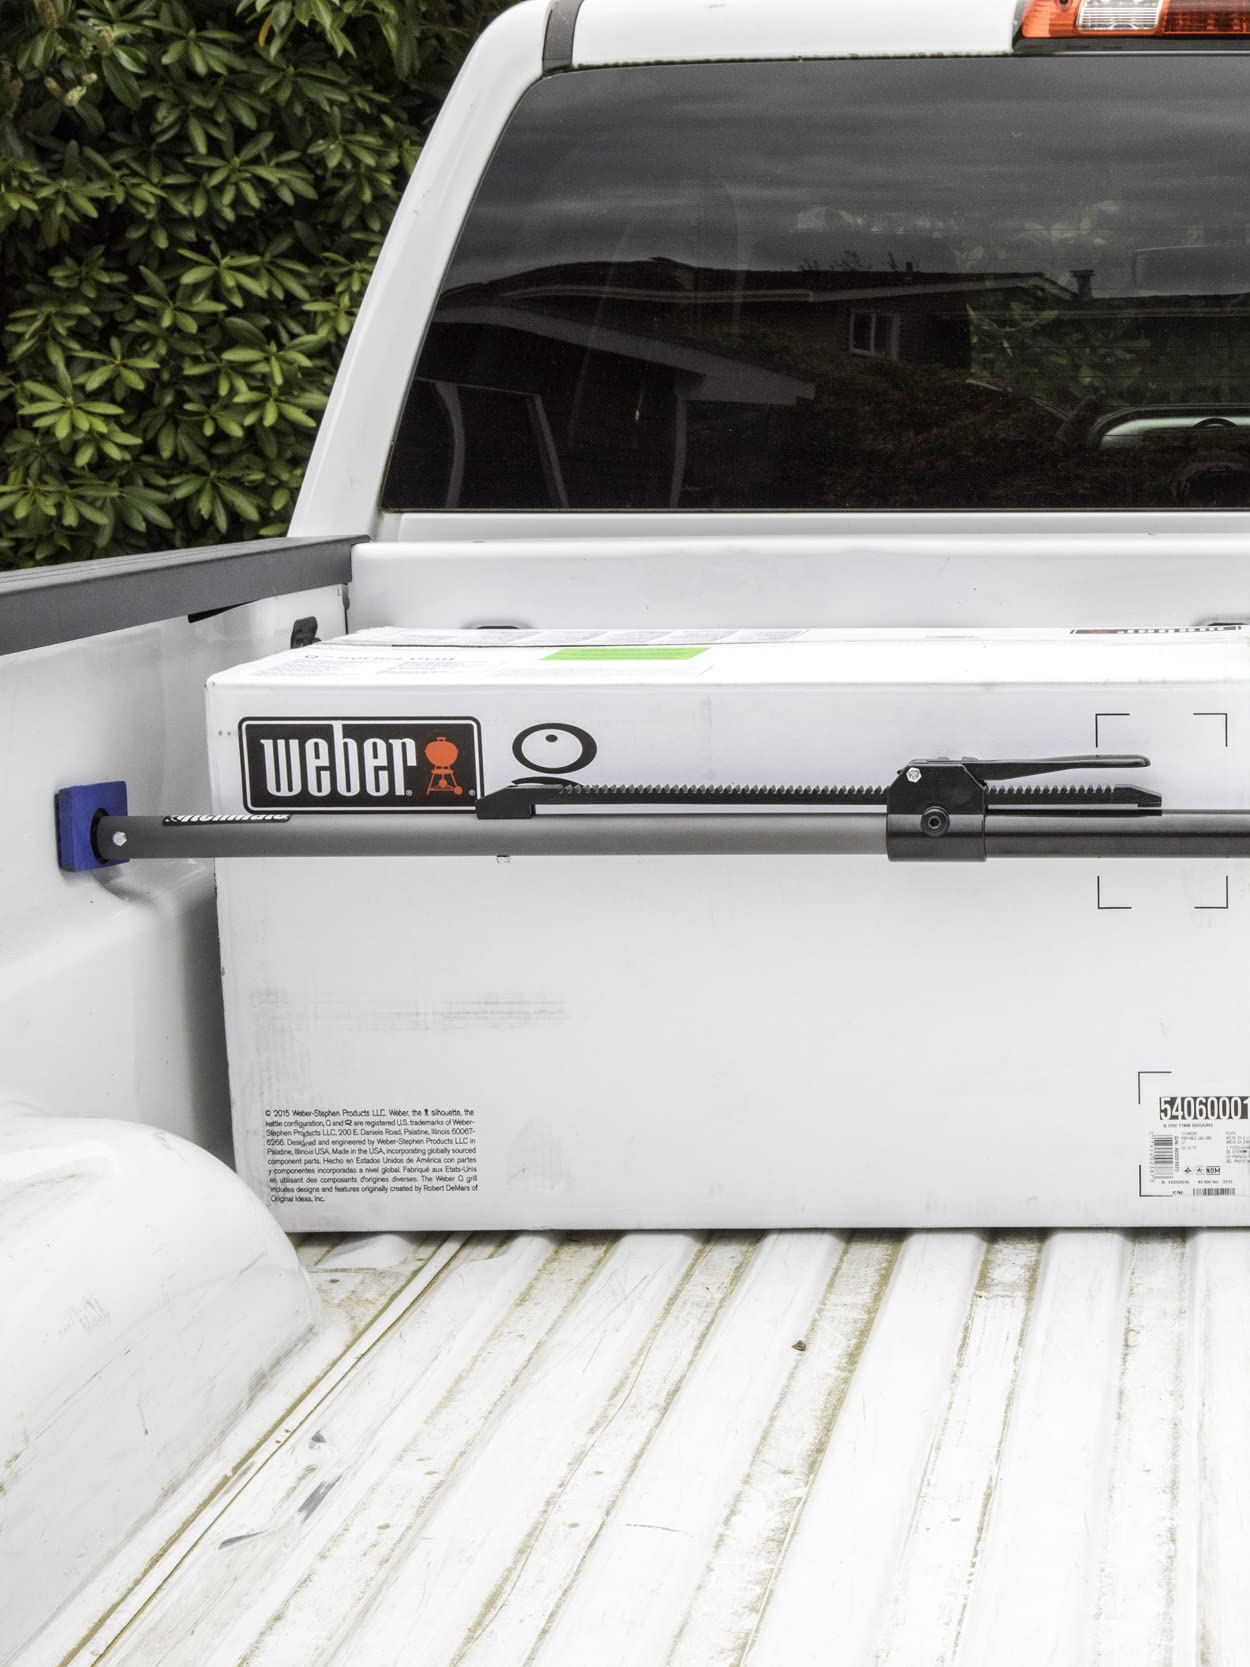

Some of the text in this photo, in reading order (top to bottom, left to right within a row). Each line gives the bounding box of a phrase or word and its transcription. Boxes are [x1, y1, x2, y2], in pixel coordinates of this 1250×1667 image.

[259, 720, 417, 797] weber
[342, 1109, 370, 1117] Products
[365, 1119, 395, 1128] registered
[360, 1128, 384, 1136] Daniels
[318, 1138, 330, 1146] and
[331, 1139, 366, 1147] engineered
[367, 1138, 375, 1147] by
[425, 1137, 453, 1145] Products
[332, 1147, 350, 1155] Made
[386, 1147, 426, 1155] incorporating
[267, 1158, 302, 1166] component
[456, 1157, 477, 1165] partes
[317, 1167, 357, 1175] incorporadas
[320, 1176, 357, 1184] composants
[295, 1186, 320, 1194] designs
[414, 1185, 422, 1193] by
[423, 1184, 444, 1192] Robert
